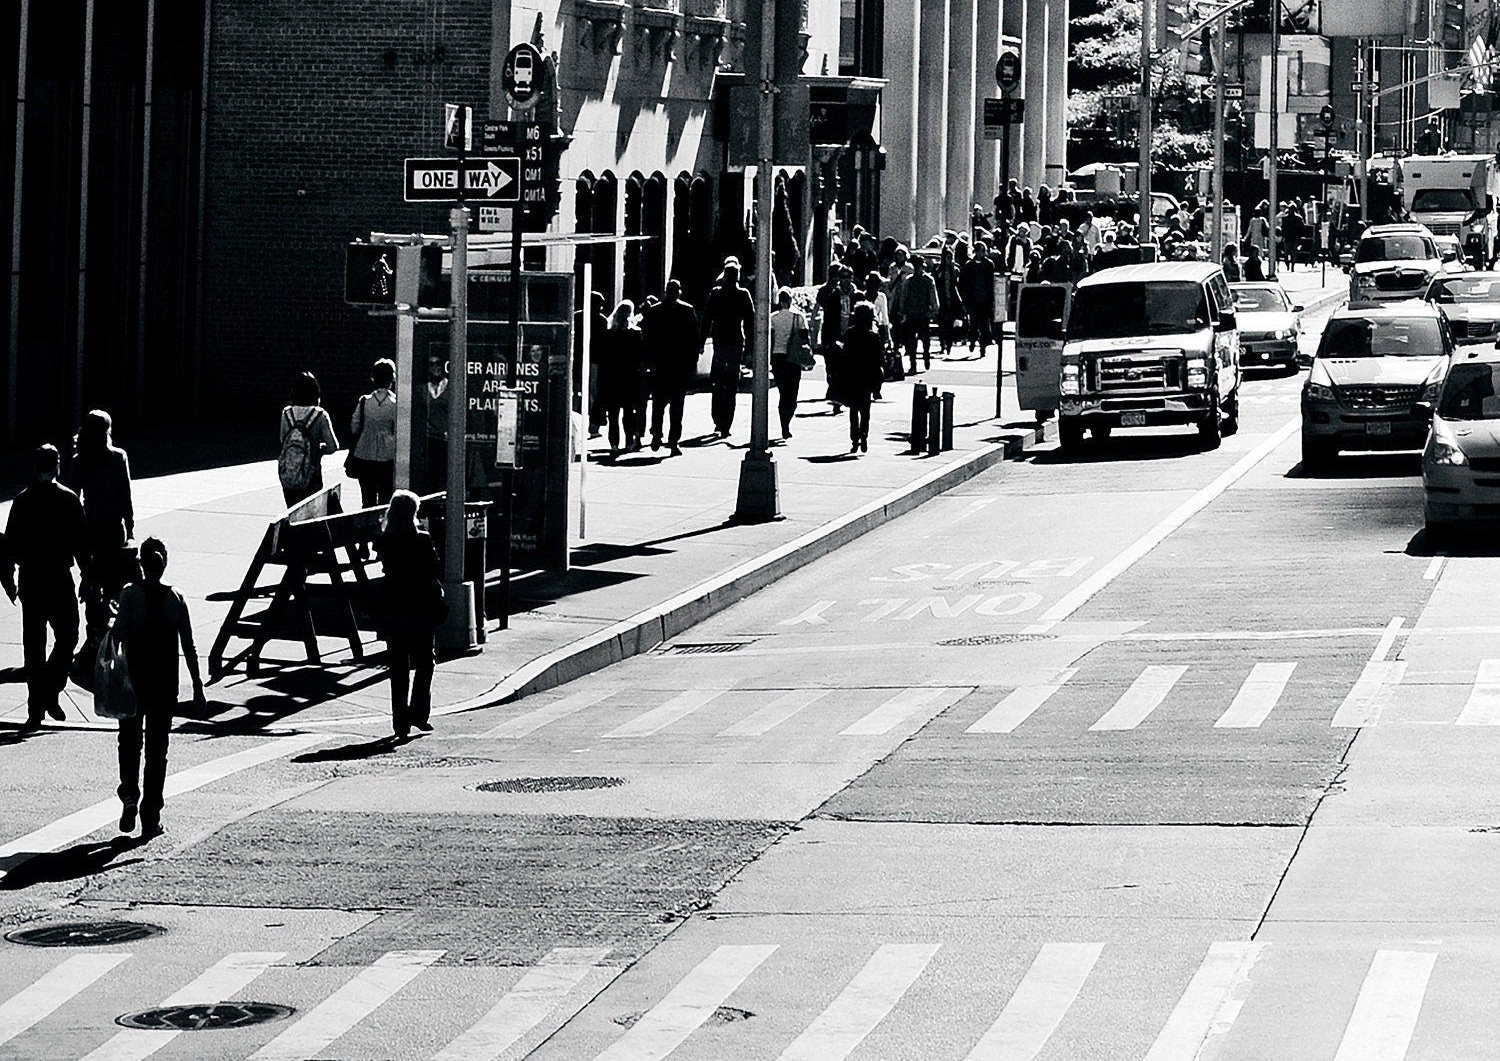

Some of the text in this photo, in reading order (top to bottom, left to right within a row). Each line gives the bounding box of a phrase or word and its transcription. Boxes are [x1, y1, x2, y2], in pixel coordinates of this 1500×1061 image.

[527, 125, 540, 140] M6
[422, 171, 501, 187] ONE WAY
[486, 362, 539, 376] AIRNES
[869, 556, 1094, 582] BUS
[777, 592, 1043, 625] ONLY
